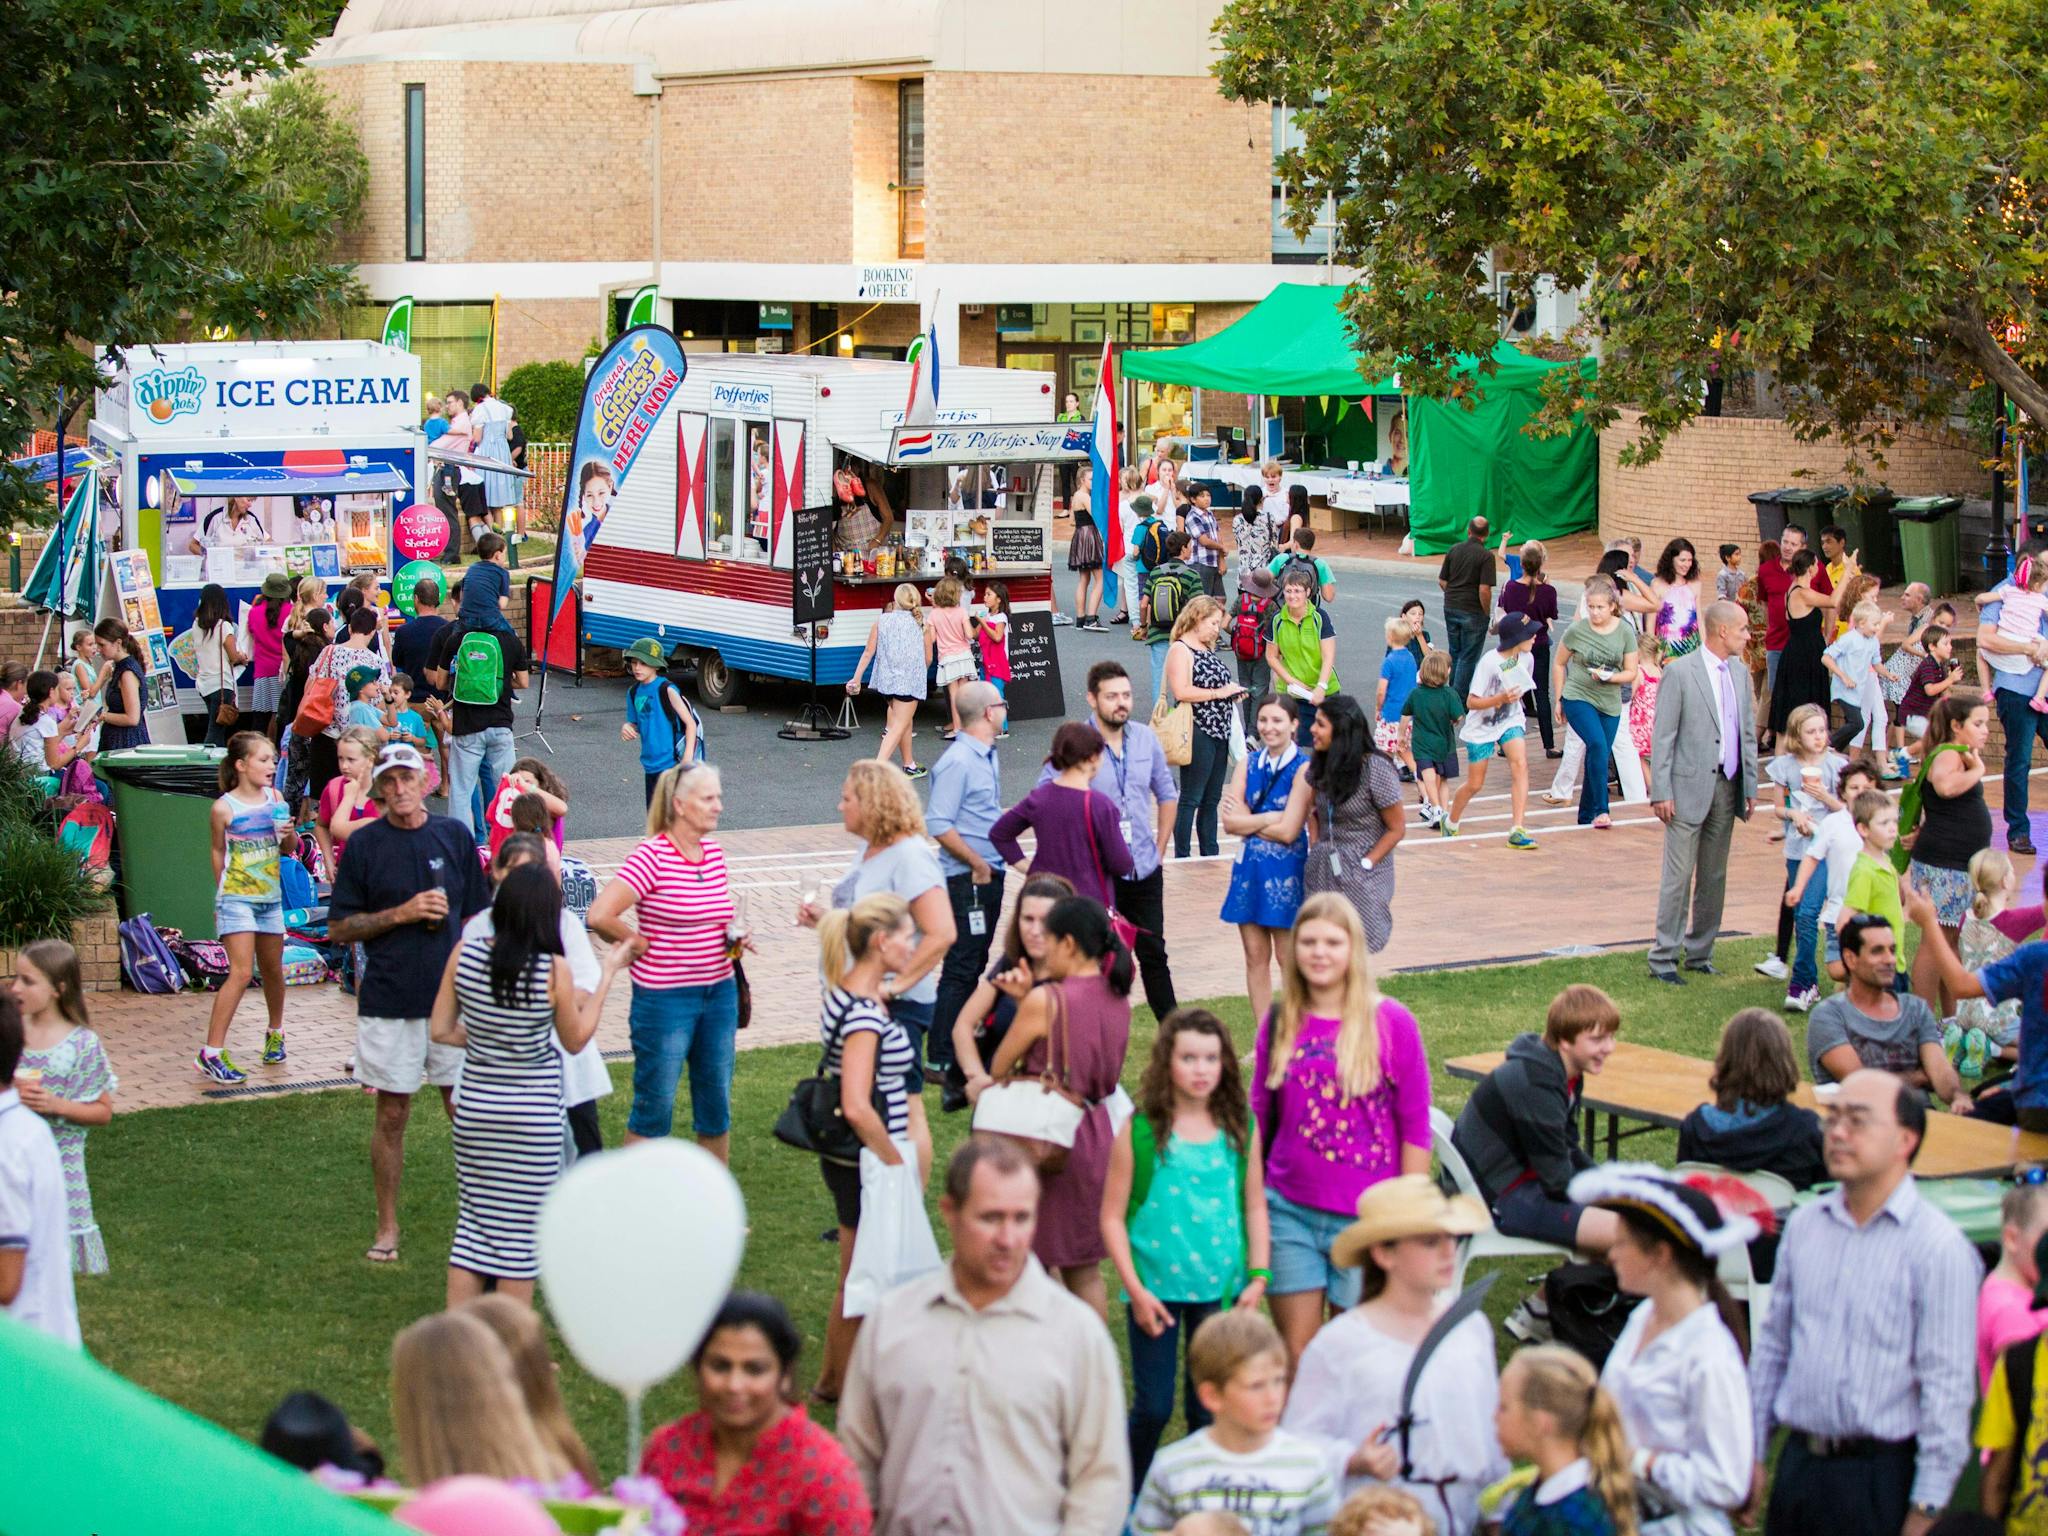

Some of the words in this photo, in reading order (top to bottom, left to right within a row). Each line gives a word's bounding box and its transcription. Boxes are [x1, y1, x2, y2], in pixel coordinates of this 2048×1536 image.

[864, 268, 913, 282] BOOKING
[868, 284, 908, 297] OFFICE
[594, 357, 627, 407] Original
[602, 349, 655, 421] Golden
[216, 381, 275, 408] ICE
[285, 378, 410, 405] CREAM
[714, 386, 769, 405] Poffertjes
[171, 395, 196, 410] dots
[613, 416, 648, 472] HERE
[643, 369, 679, 416] NOW
[936, 433, 960, 449] The
[964, 431, 1028, 450] Poffertjes
[1030, 430, 1061, 451] Shop
[400, 516, 413, 524] Ice
[416, 514, 446, 523] Cream
[403, 525, 442, 537] Yoghurt
[405, 539, 440, 548] Sherbet
[416, 550, 430, 559] Ice
[398, 573, 415, 581] Non
[1021, 622, 1035, 632] $8
[1038, 635, 1049, 644] $8
[1031, 646, 1043, 654] $2
